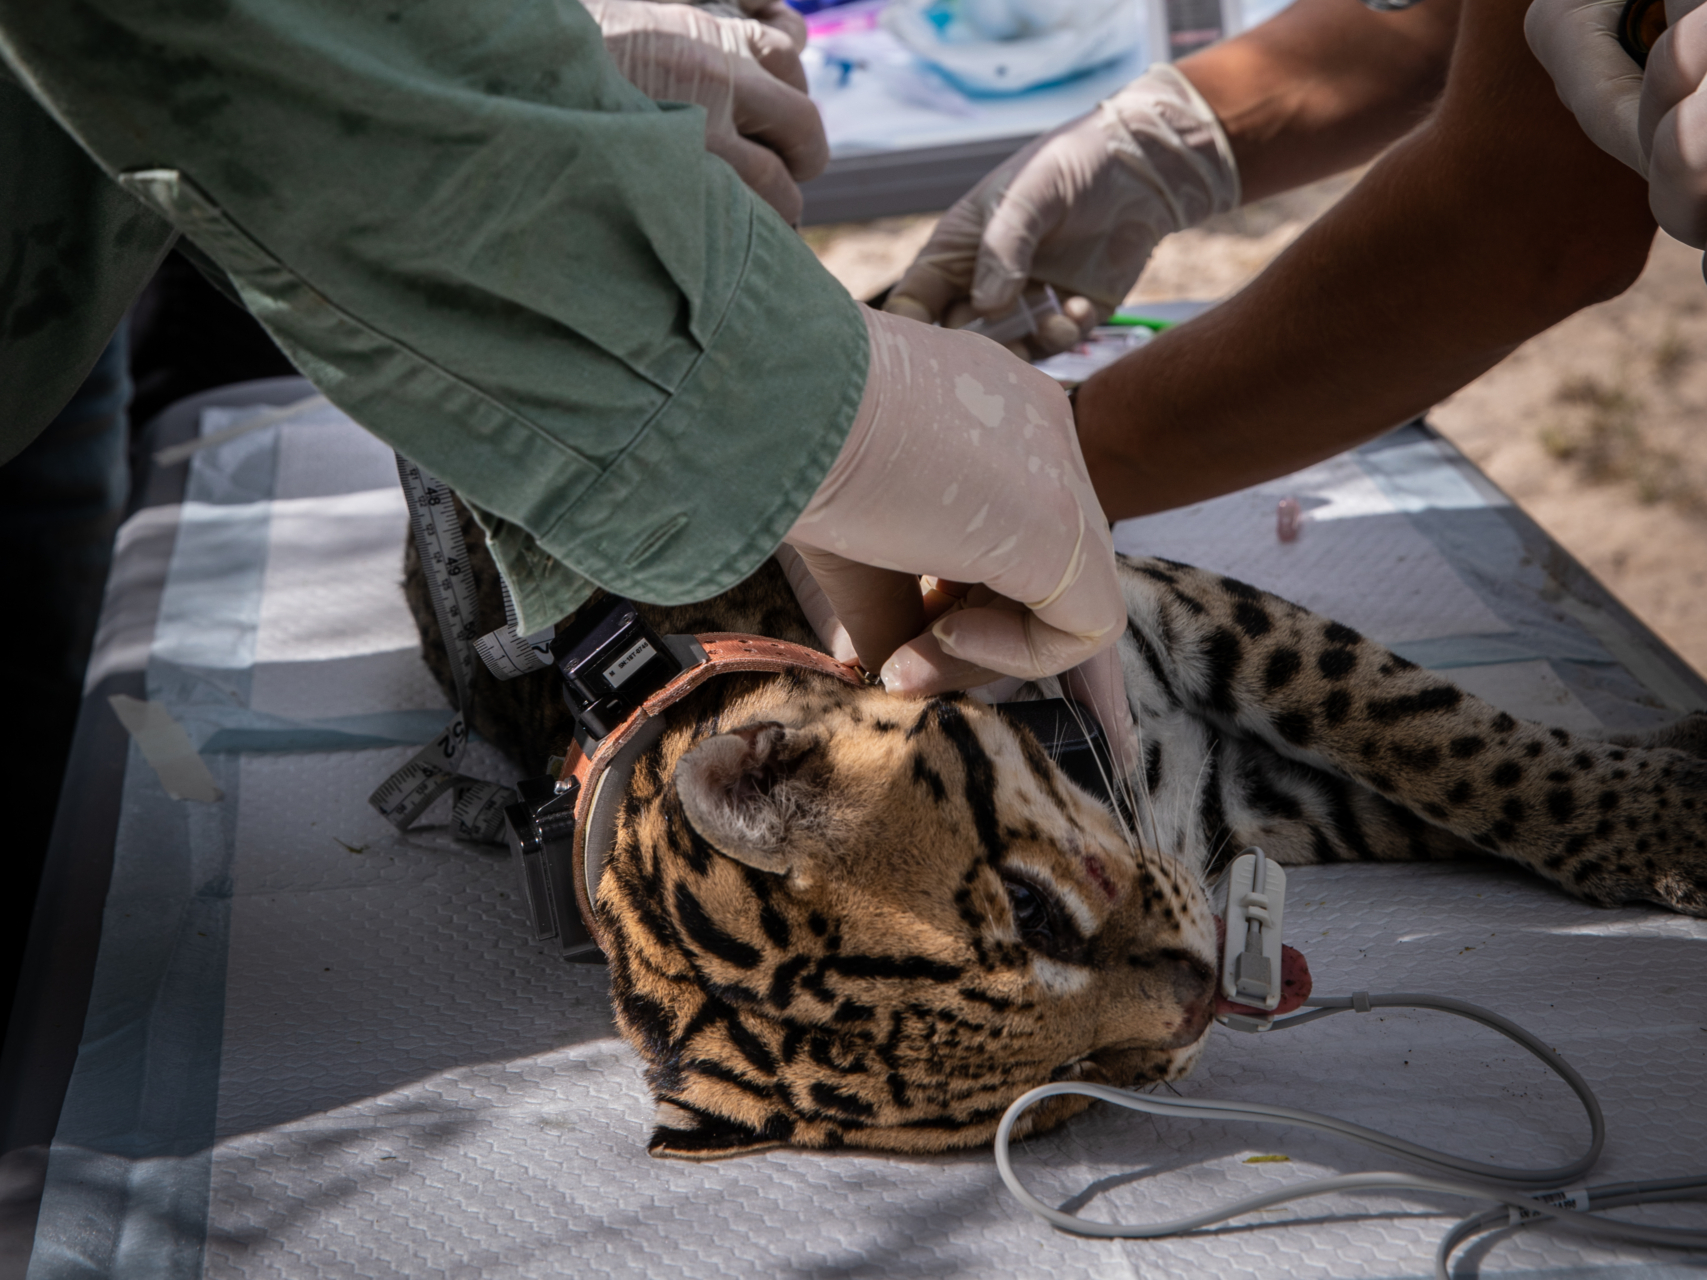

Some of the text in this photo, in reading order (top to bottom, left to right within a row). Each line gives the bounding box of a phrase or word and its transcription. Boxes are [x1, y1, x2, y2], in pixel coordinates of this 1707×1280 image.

[409, 468, 419, 480] 121
[418, 495, 427, 507] 122
[425, 523, 435, 536] 123
[433, 551, 443, 563] 124
[425, 486, 478, 640] 48 49 50
